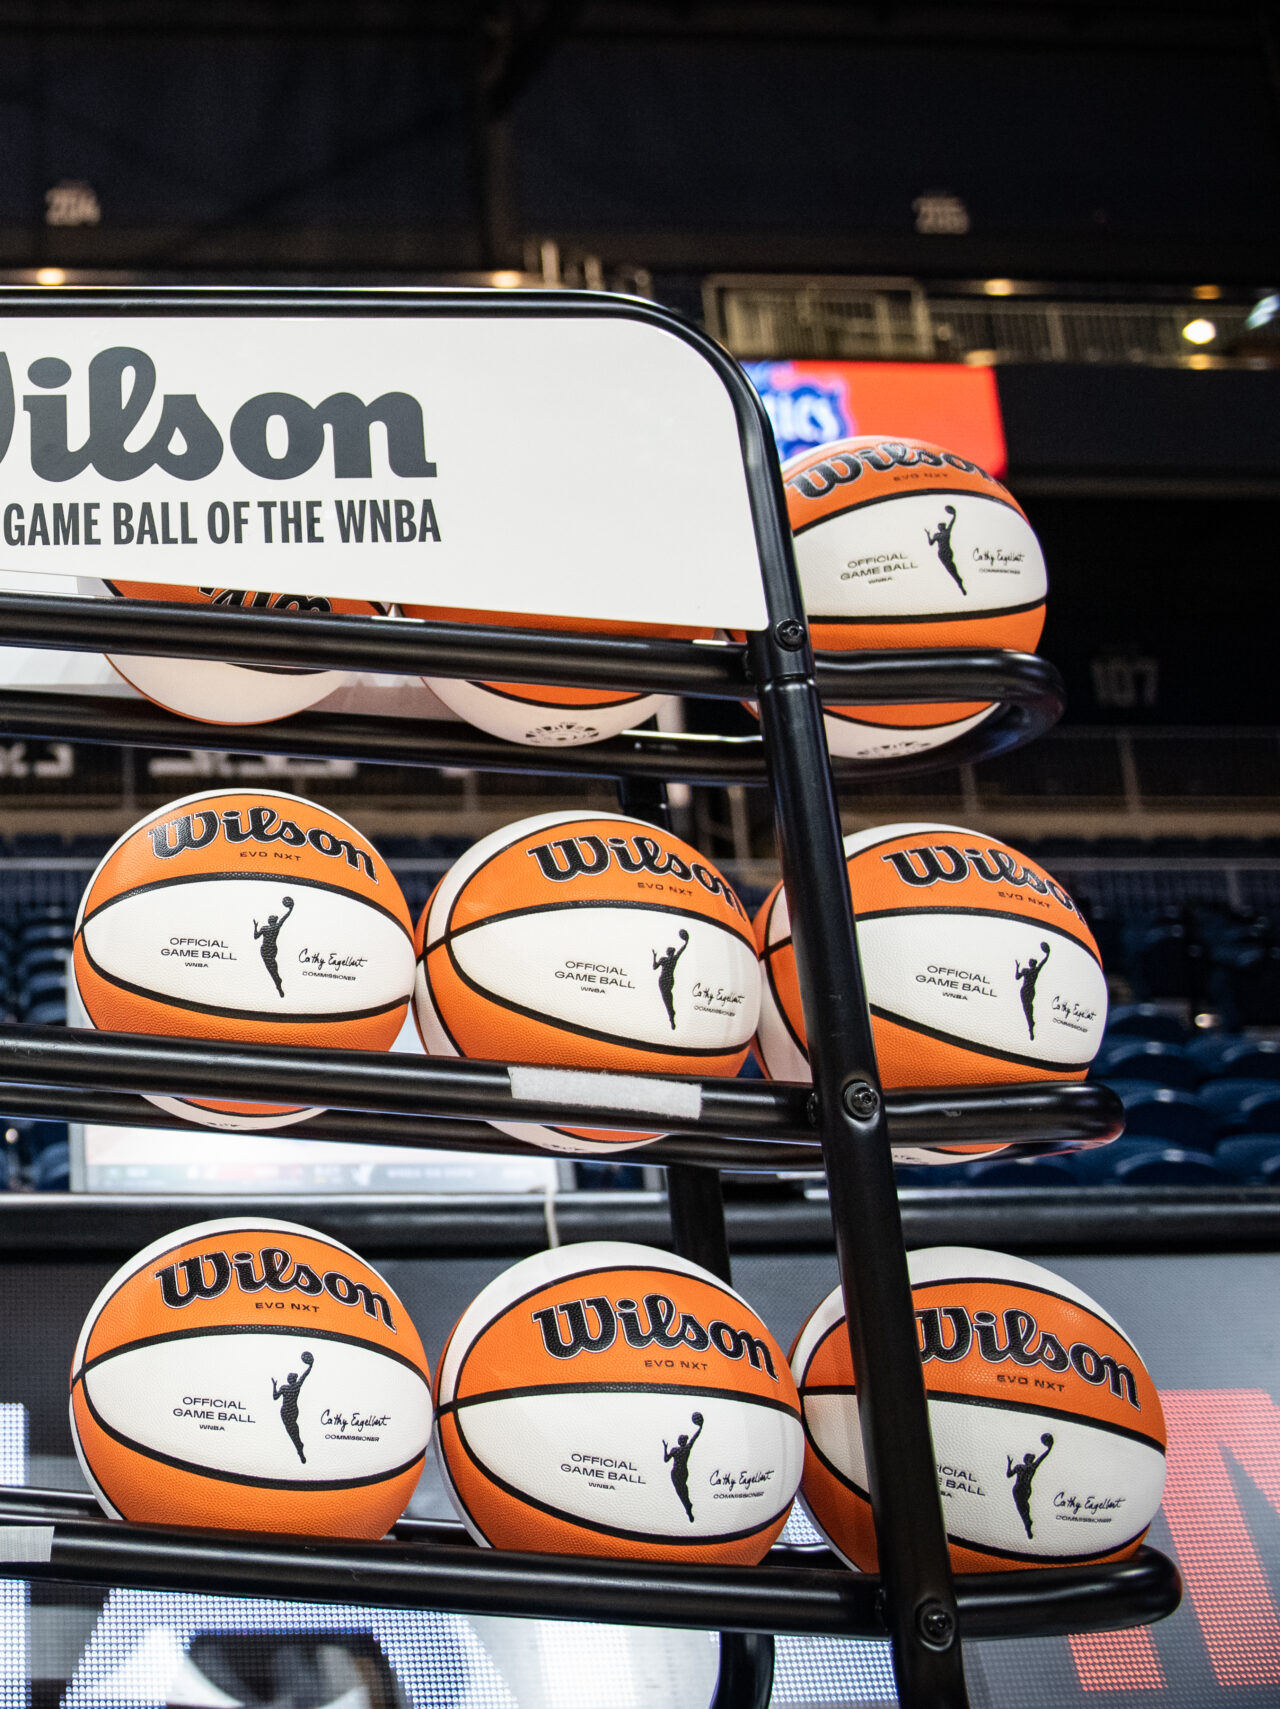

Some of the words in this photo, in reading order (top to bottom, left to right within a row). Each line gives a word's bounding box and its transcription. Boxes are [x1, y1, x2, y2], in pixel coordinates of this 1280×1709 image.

[3, 502, 101, 547] GAME
[113, 501, 197, 545] BALL
[207, 501, 250, 544] OF
[258, 500, 324, 544] THE
[336, 499, 441, 543] WNBA
[848, 553, 908, 569] OFFICIAL
[840, 565, 881, 581] GAME
[883, 562, 918, 573] BALL
[146, 806, 379, 885] Wilson
[273, 852, 302, 862] NXT
[526, 834, 747, 923] Wilson
[880, 844, 1087, 926] Wilso
[637, 882, 664, 891] EVO
[669, 886, 693, 897] NXT
[169, 937, 229, 949] OFFICIAL
[160, 949, 199, 959] GAME
[201, 950, 238, 961] BALL
[302, 971, 357, 981] COMMISSIONER
[565, 960, 628, 976] OFFICIAL
[927, 965, 991, 984] OFFICIAL
[554, 971, 597, 984] GAME
[599, 976, 636, 989] BALL
[915, 974, 958, 989] GAME
[961, 982, 998, 998] BALL
[580, 986, 606, 994] WNBA
[942, 991, 968, 1001] WNBA
[154, 1247, 398, 1335] Wilson
[255, 1301, 285, 1309] EVO
[290, 1303, 320, 1313] NXT
[531, 1293, 779, 1383] Wilson
[644, 1359, 674, 1368] EVO
[680, 1361, 708, 1371] NXT
[914, 1305, 1141, 1412] Wilson
[997, 1374, 1028, 1385] EVO
[1034, 1379, 1065, 1392] NXT
[182, 1396, 247, 1410] OFFICIAL
[173, 1408, 215, 1420] GAME
[217, 1411, 256, 1424] BALL
[199, 1423, 225, 1431] WNBA
[325, 1433, 380, 1442] COMMISSIONER
[570, 1453, 638, 1471] OFFICIAL
[560, 1463, 605, 1479] GAME
[608, 1470, 646, 1485] BALL
[936, 1464, 977, 1482] ICIAL
[588, 1481, 616, 1490] WNBA
[945, 1479, 985, 1497] BALL
